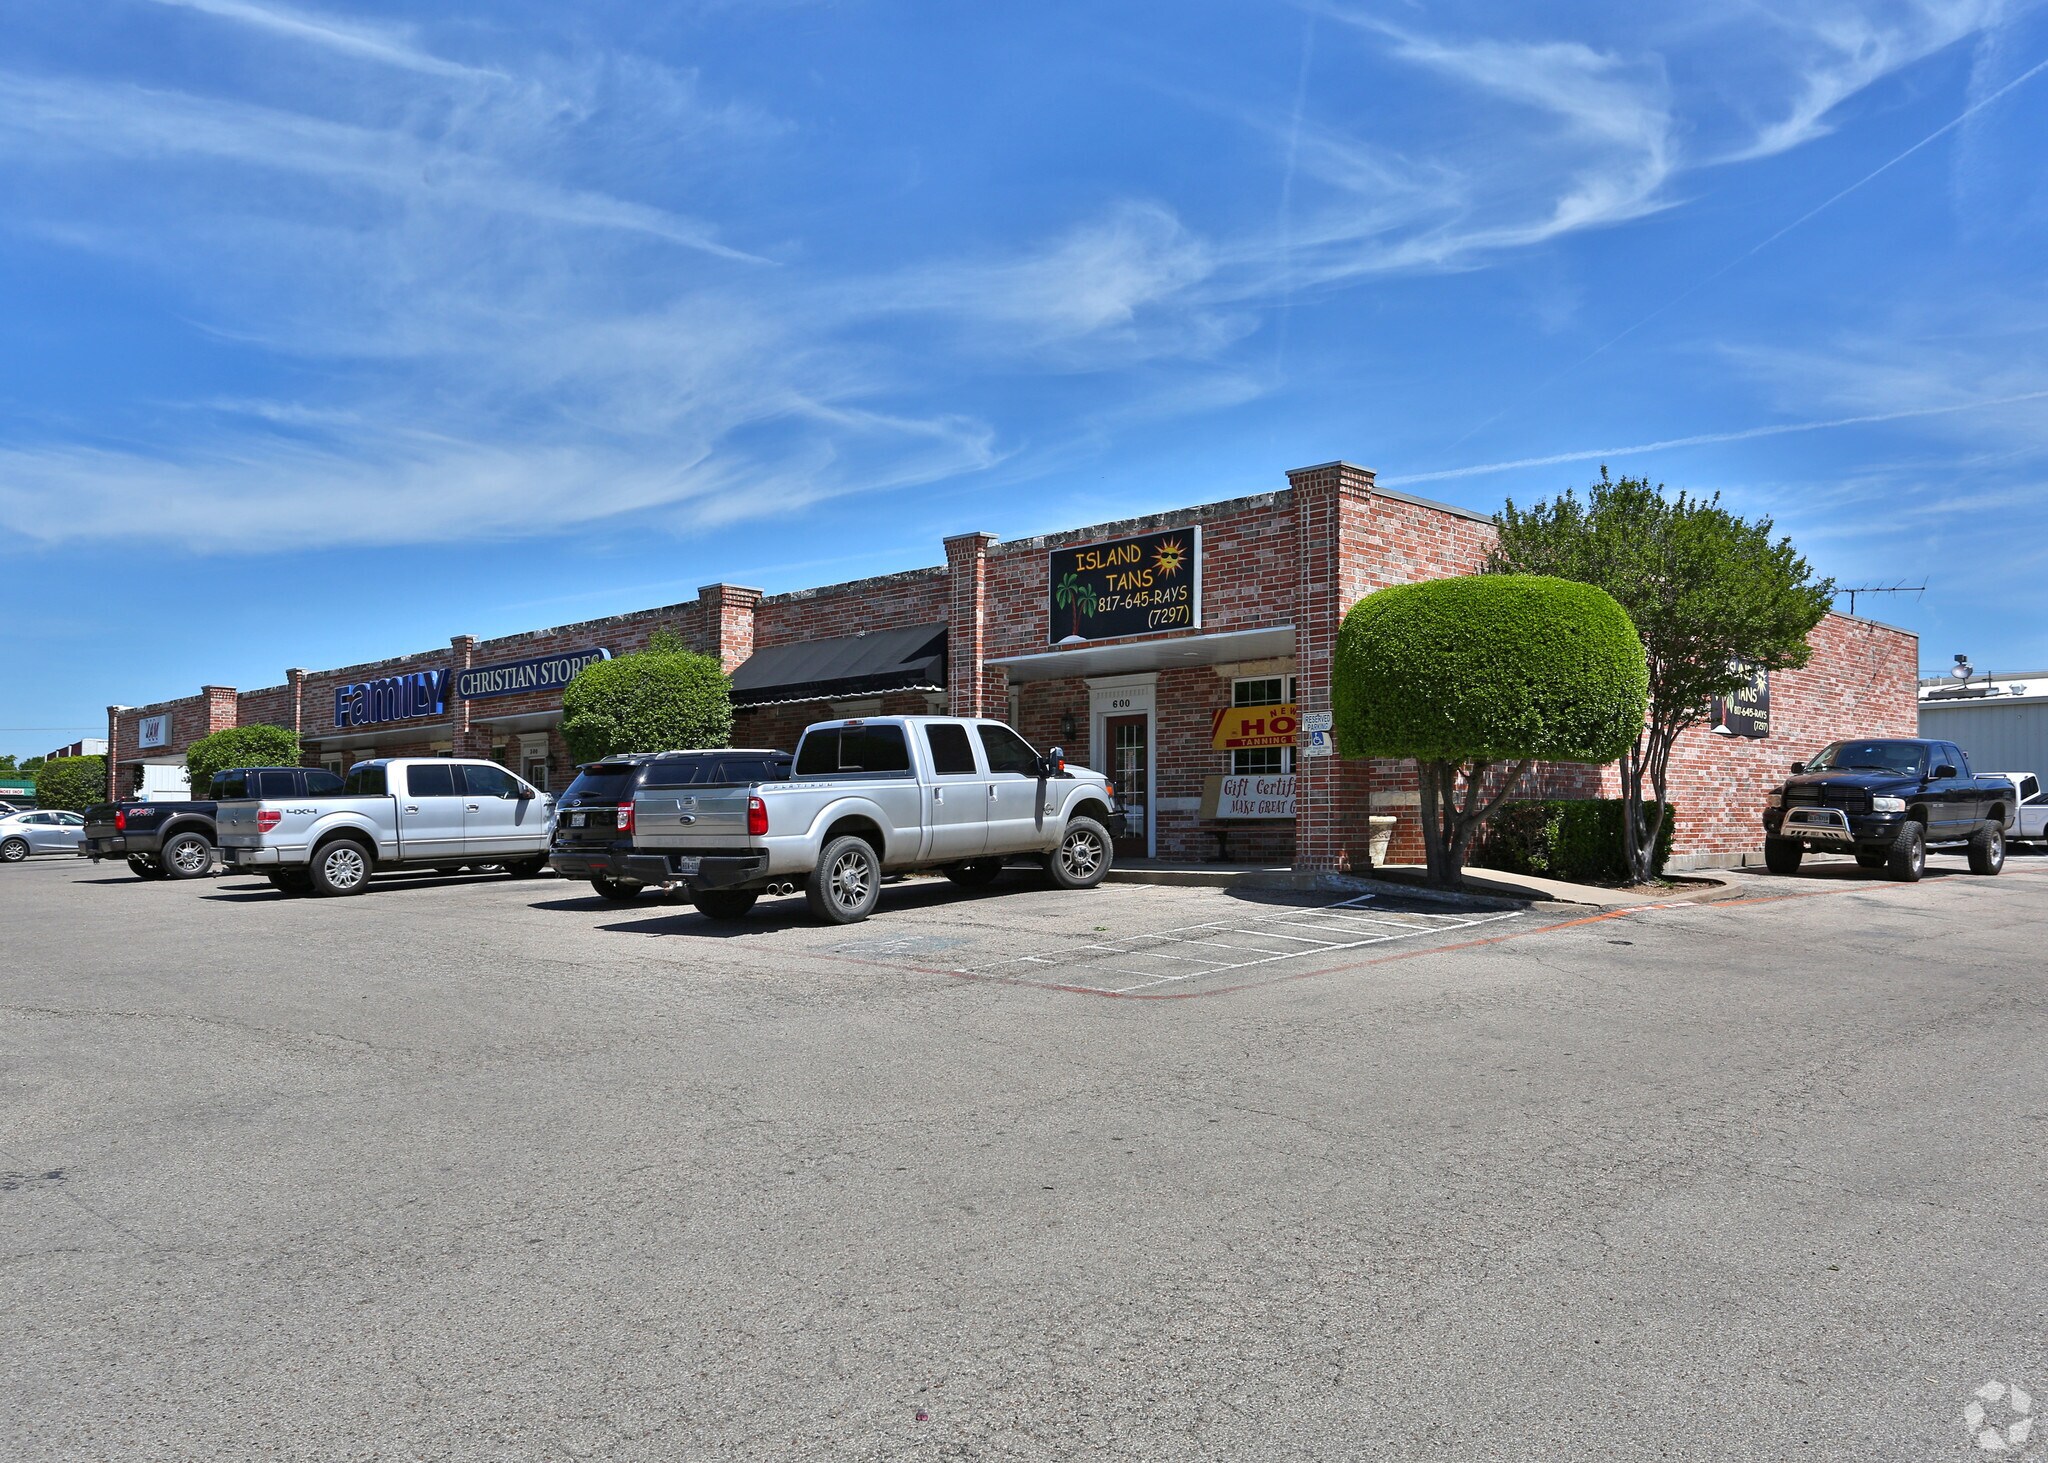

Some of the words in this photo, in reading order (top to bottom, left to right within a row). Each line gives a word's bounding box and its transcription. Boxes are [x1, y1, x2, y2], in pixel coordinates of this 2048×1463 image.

[1076, 544, 1142, 572] ISLAND
[1106, 569, 1154, 592] TANS
[1098, 585, 1188, 613] 817-645-RAYS
[1148, 604, 1190, 629] (7297)
[460, 664, 537, 696] CHRISTIAN
[1112, 699, 1130, 708] 600
[1305, 714, 1331, 724] RESERVED
[1307, 723, 1329, 731] PARKING
[1241, 736, 1287, 746] TANNING
[1224, 778, 1248, 798] Gift
[1230, 800, 1256, 815] MAKE
[1258, 800, 1287, 814] GREAT
